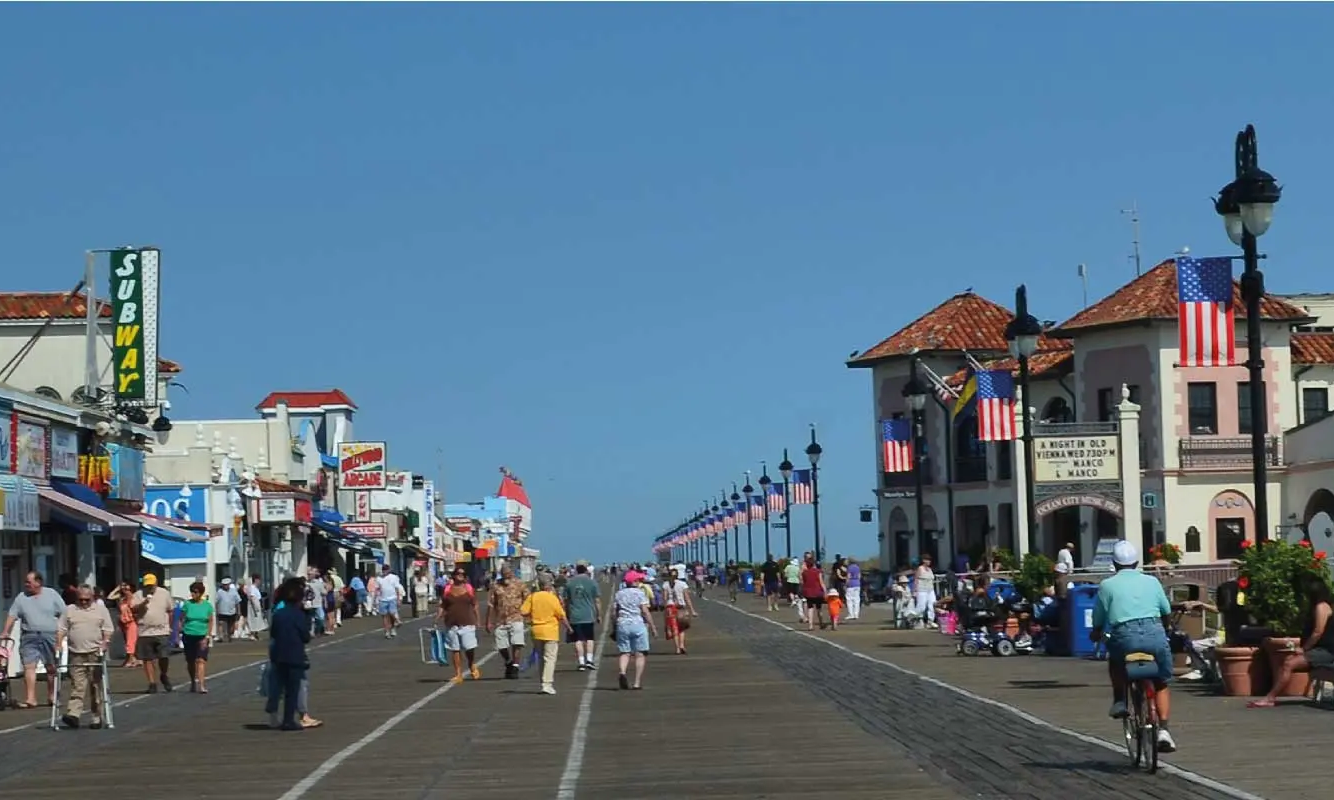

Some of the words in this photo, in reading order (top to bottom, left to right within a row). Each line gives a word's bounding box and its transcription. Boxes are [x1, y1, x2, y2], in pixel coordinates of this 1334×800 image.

[114, 253, 141, 393] SUBWAY
[1040, 441, 1046, 449] A
[1050, 440, 1075, 448] NIGHT
[1077, 440, 1085, 448] IN
[1089, 439, 1107, 448] OLD
[1036, 450, 1066, 459] VIENNA
[1067, 449, 1085, 458] WED
[1073, 459, 1104, 468] MANCO
[1067, 469, 1098, 477] MANCO
